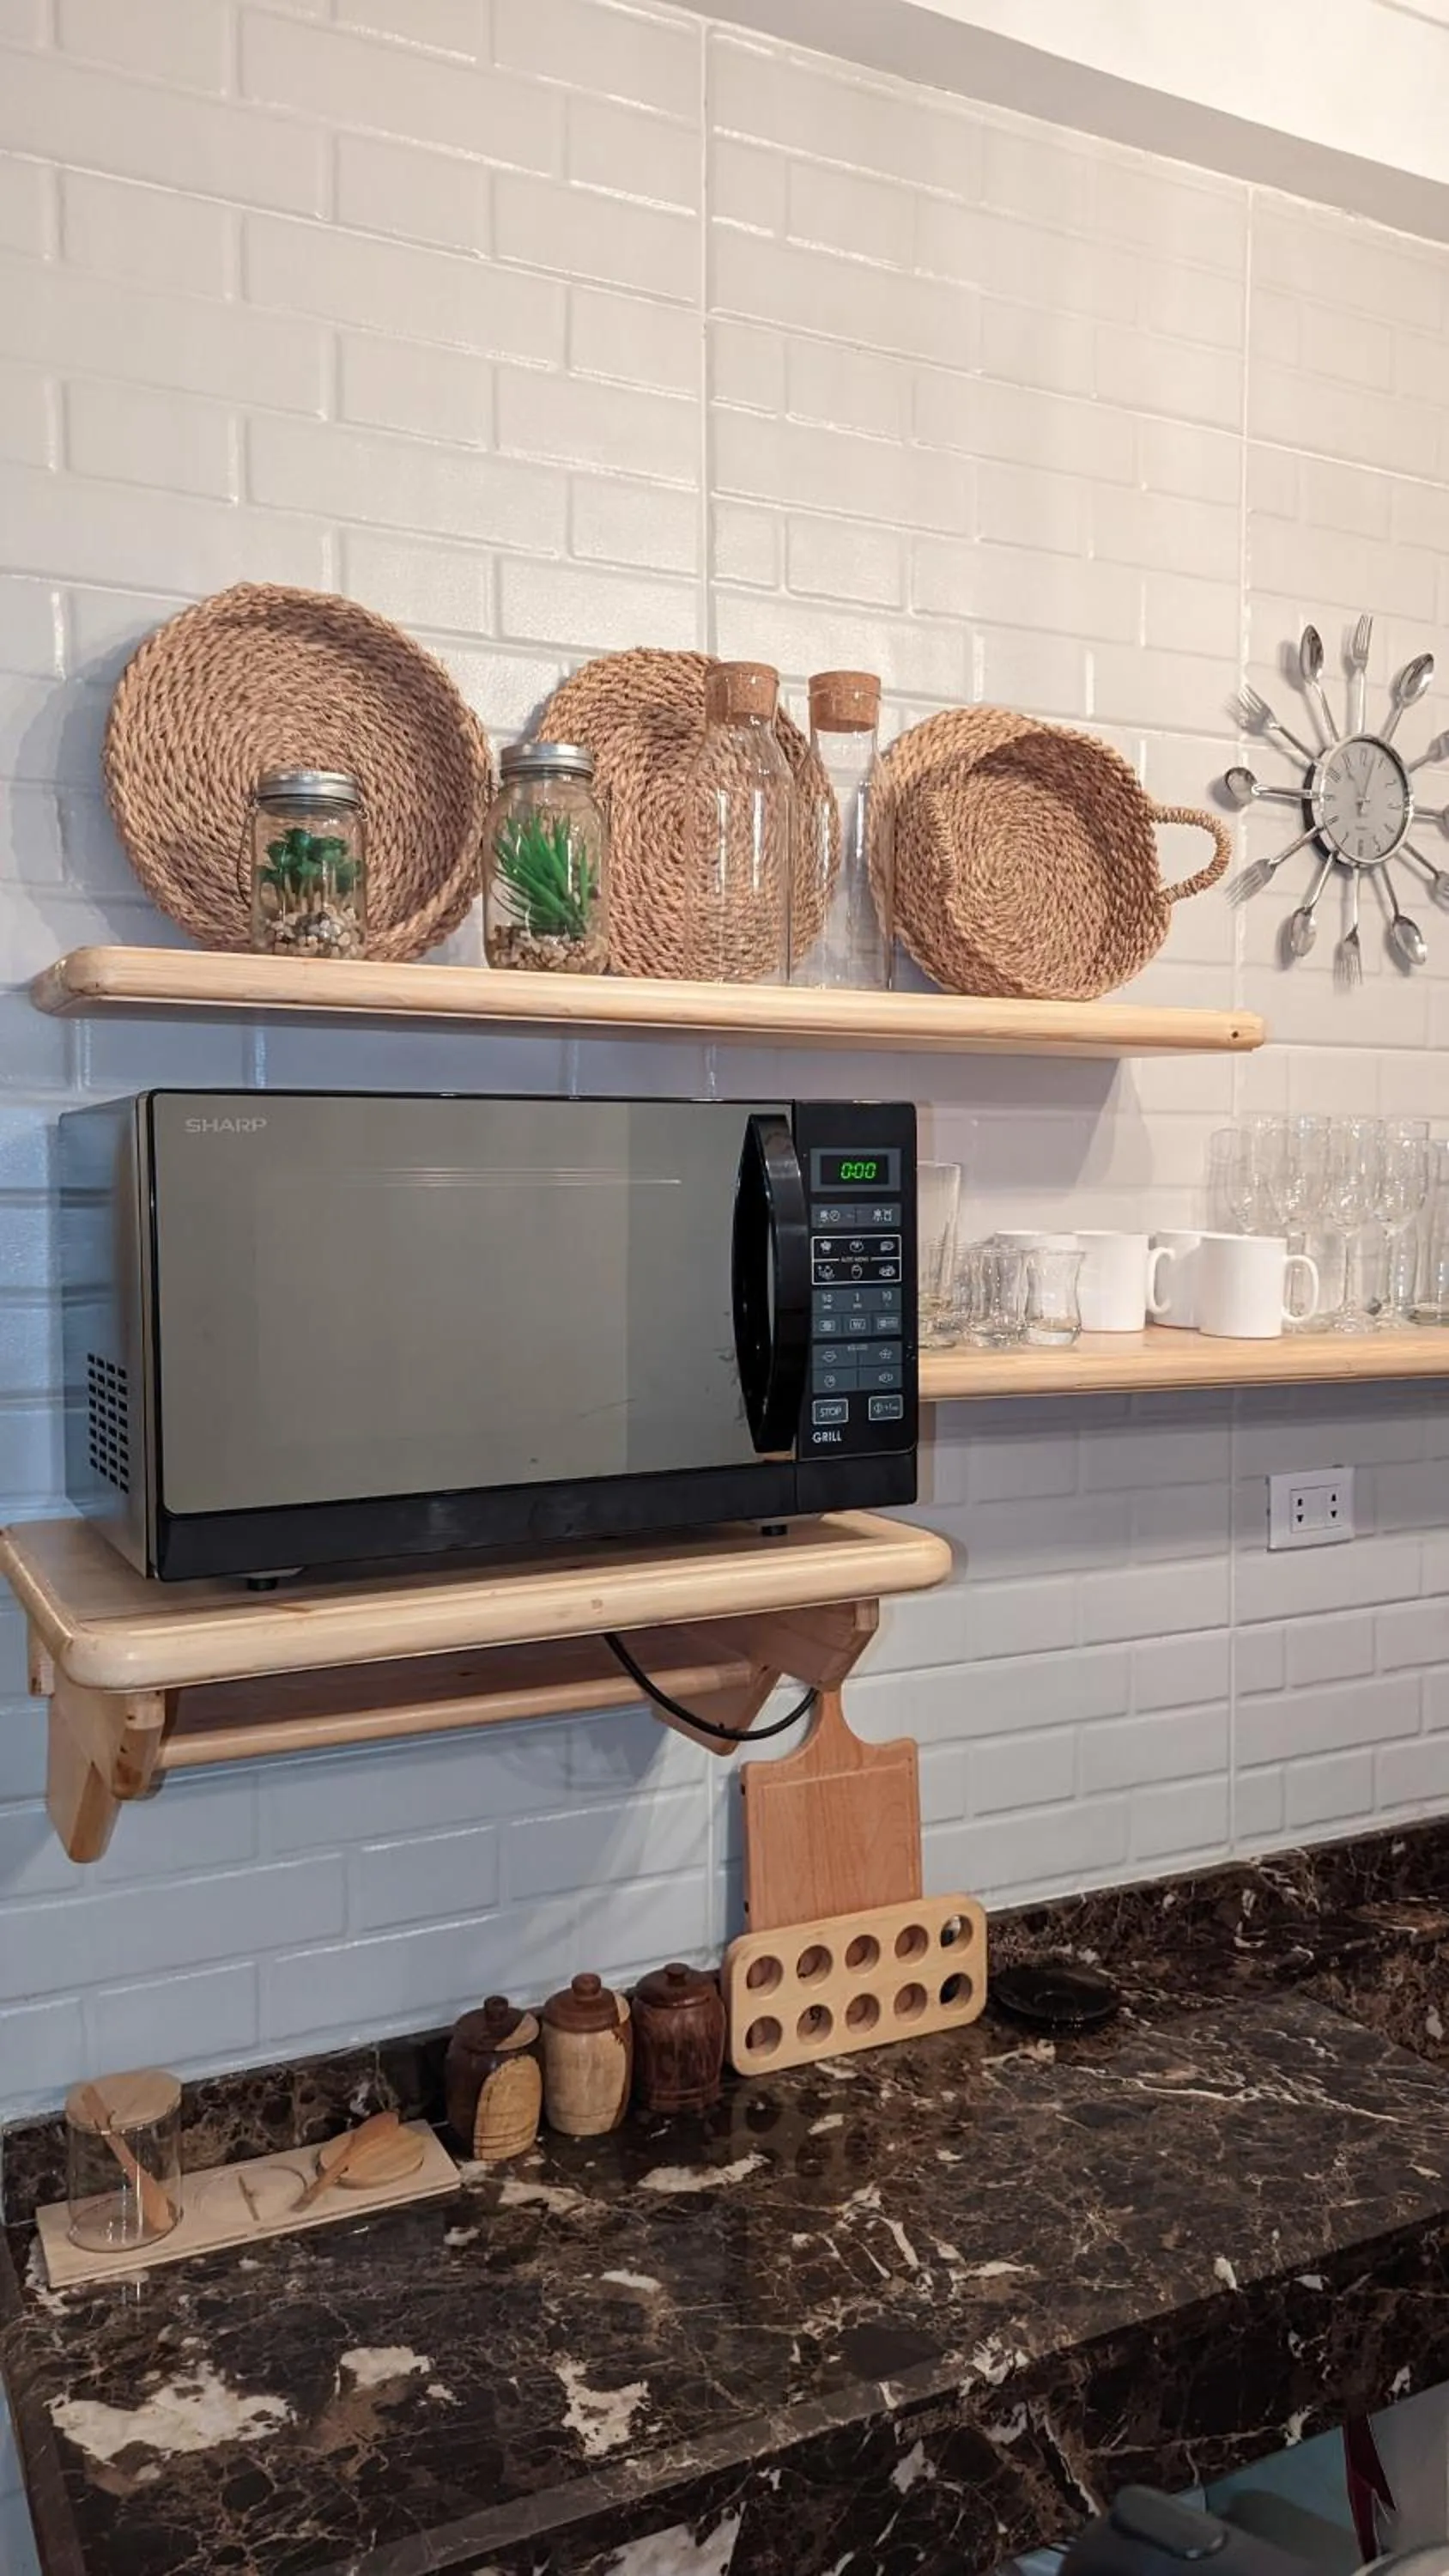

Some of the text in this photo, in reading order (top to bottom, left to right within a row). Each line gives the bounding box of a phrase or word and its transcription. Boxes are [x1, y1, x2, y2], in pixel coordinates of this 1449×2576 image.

[185, 1117, 268, 1133] SHARP
[820, 1406, 842, 1418] STOP
[812, 1430, 842, 1443] GRILL
